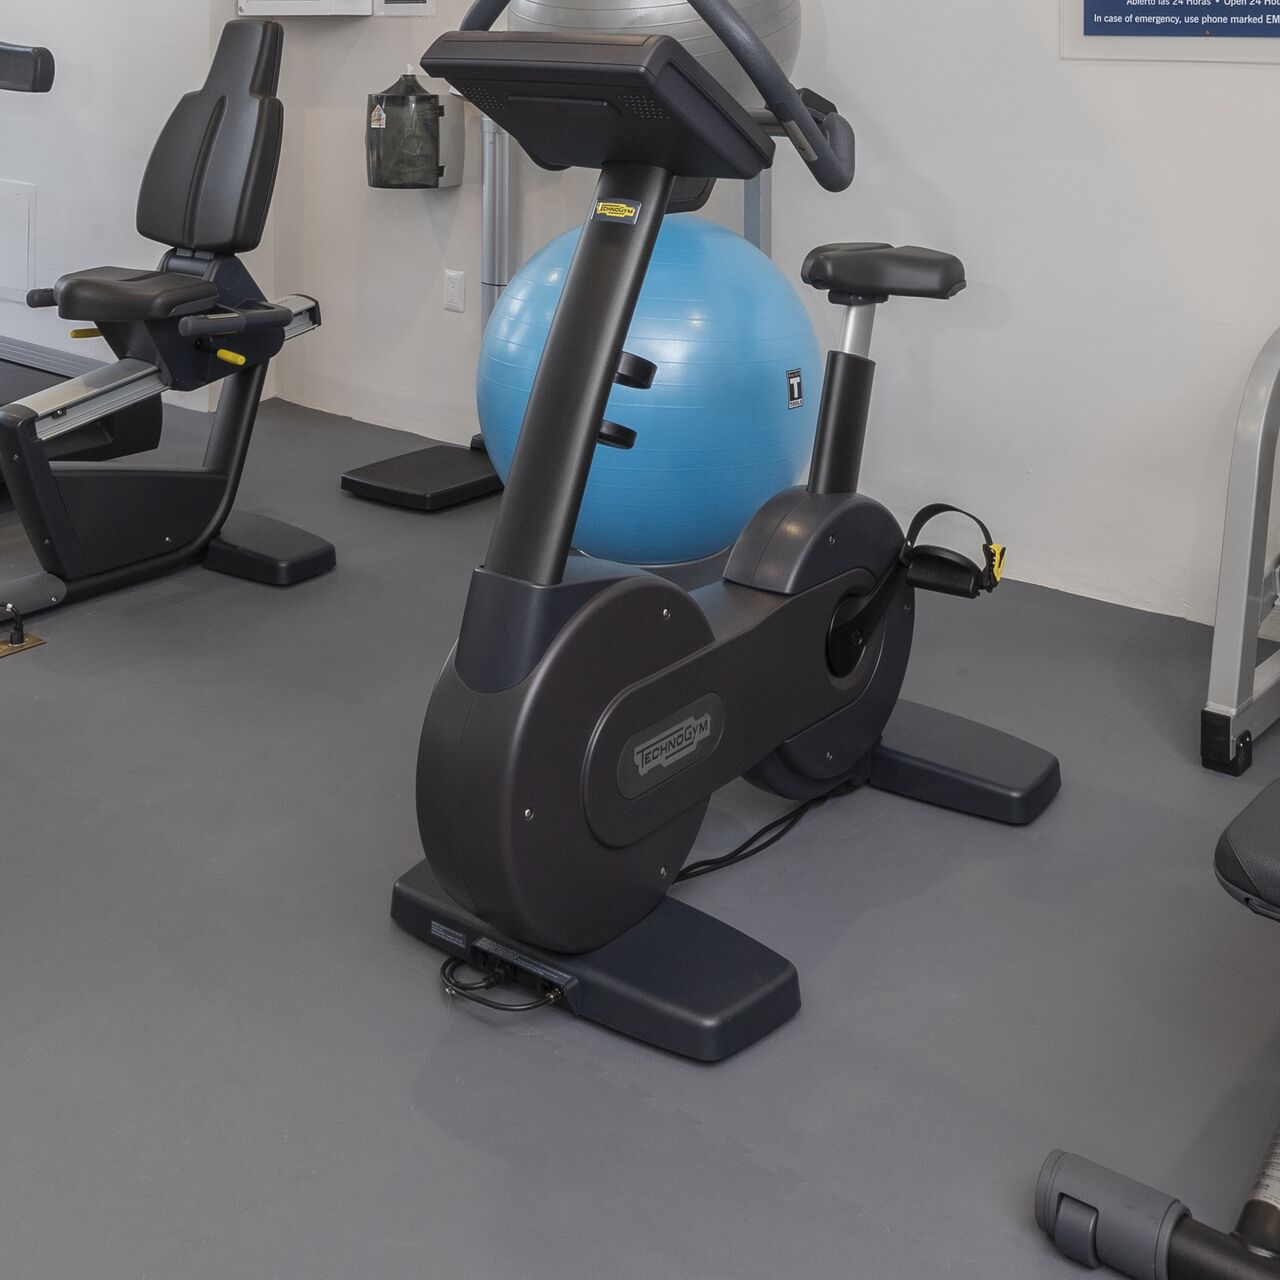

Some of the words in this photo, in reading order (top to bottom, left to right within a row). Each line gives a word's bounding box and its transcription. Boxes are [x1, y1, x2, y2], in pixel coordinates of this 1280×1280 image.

[1093, 13, 1102, 23] In
[1103, 15, 1123, 23] case
[1124, 13, 1133, 23] of
[1134, 15, 1182, 25] emergency,
[1184, 16, 1200, 24] use
[1201, 14, 1228, 25] phone
[1230, 14, 1264, 24] marked
[636, 719, 709, 770] TECHNOGYM
